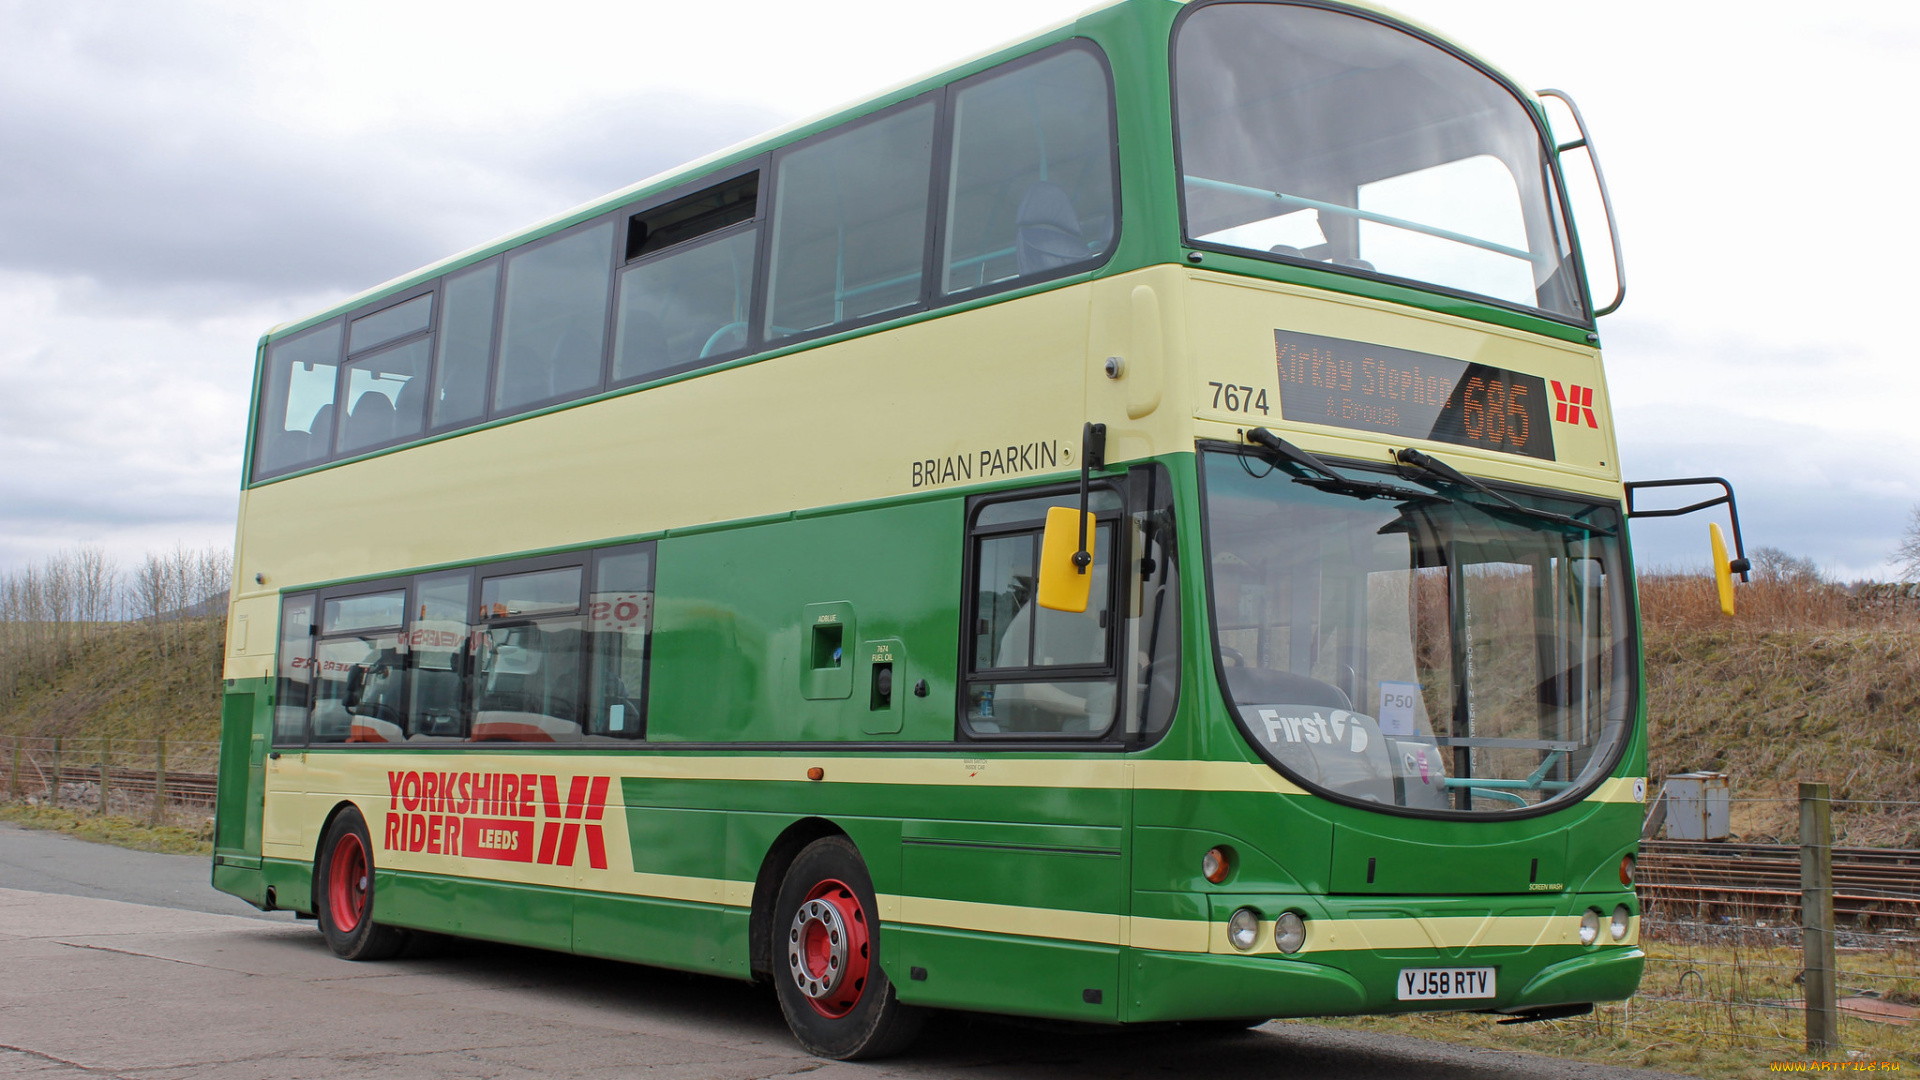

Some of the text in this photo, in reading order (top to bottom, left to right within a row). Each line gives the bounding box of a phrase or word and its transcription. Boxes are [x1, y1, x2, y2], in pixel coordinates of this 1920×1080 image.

[1275, 341, 1452, 408] Kirkby Stephen
[1208, 381, 1270, 415] 7674
[1342, 398, 1400, 427] Brough
[1464, 376, 1529, 447] 685
[912, 439, 1057, 488] BRIAN PARKIN
[872, 653, 893, 662] FUEL OIL
[1384, 694, 1413, 709] P50
[1258, 709, 1332, 745] First
[388, 771, 538, 818] YORKSHIRE
[385, 812, 519, 856] RIDER LEEDS
[1405, 971, 1487, 995] YJ58 RTV
